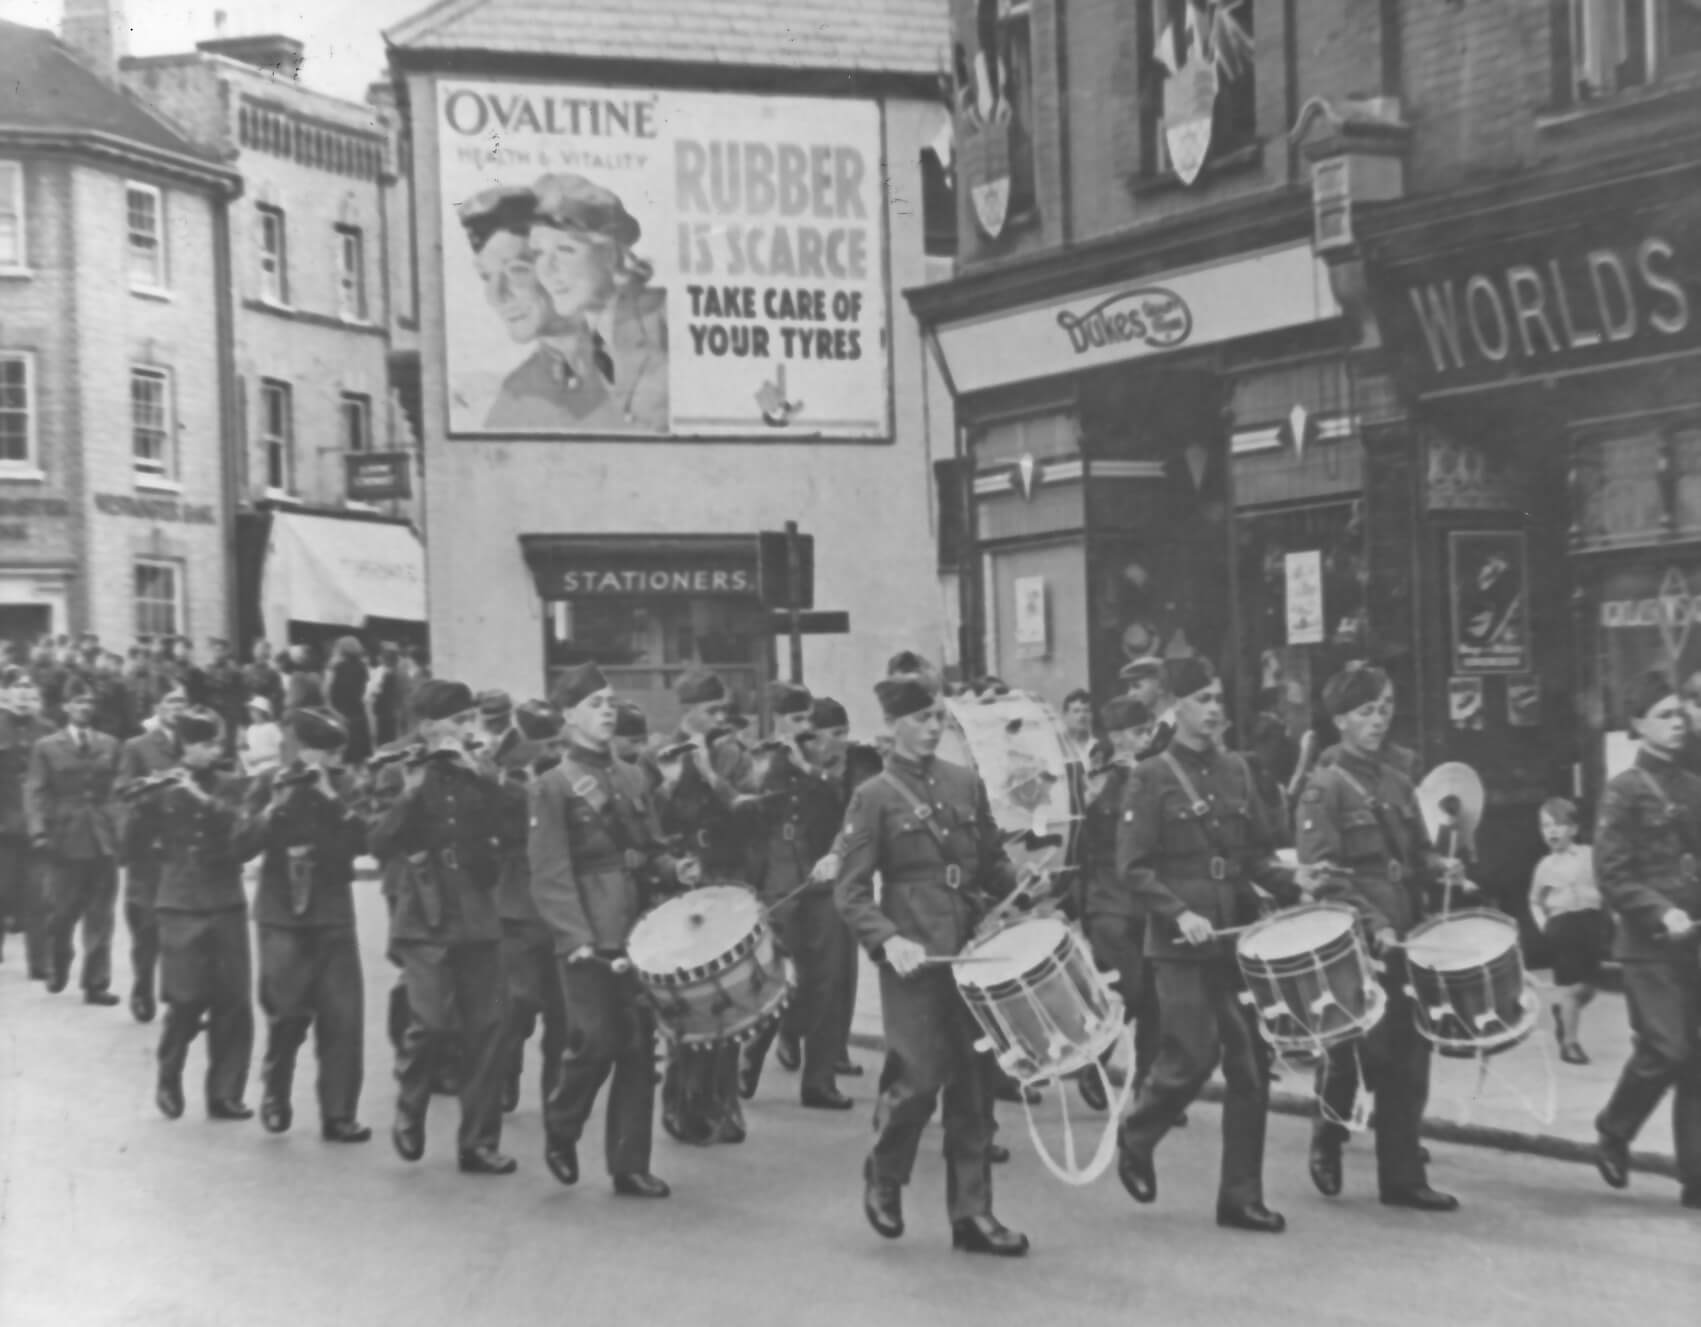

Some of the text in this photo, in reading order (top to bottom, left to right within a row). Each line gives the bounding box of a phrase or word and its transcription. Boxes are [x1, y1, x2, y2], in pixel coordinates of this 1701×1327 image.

[558, 150, 650, 170] VITALITY
[674, 138, 867, 219] RUBBER
[678, 221, 867, 279] IS SCARCE
[687, 285, 862, 322] TAKE CARE OF
[1408, 236, 1690, 373] WORLDS
[689, 324, 862, 360] YOUR TYRES
[1056, 305, 1147, 354] Dukes
